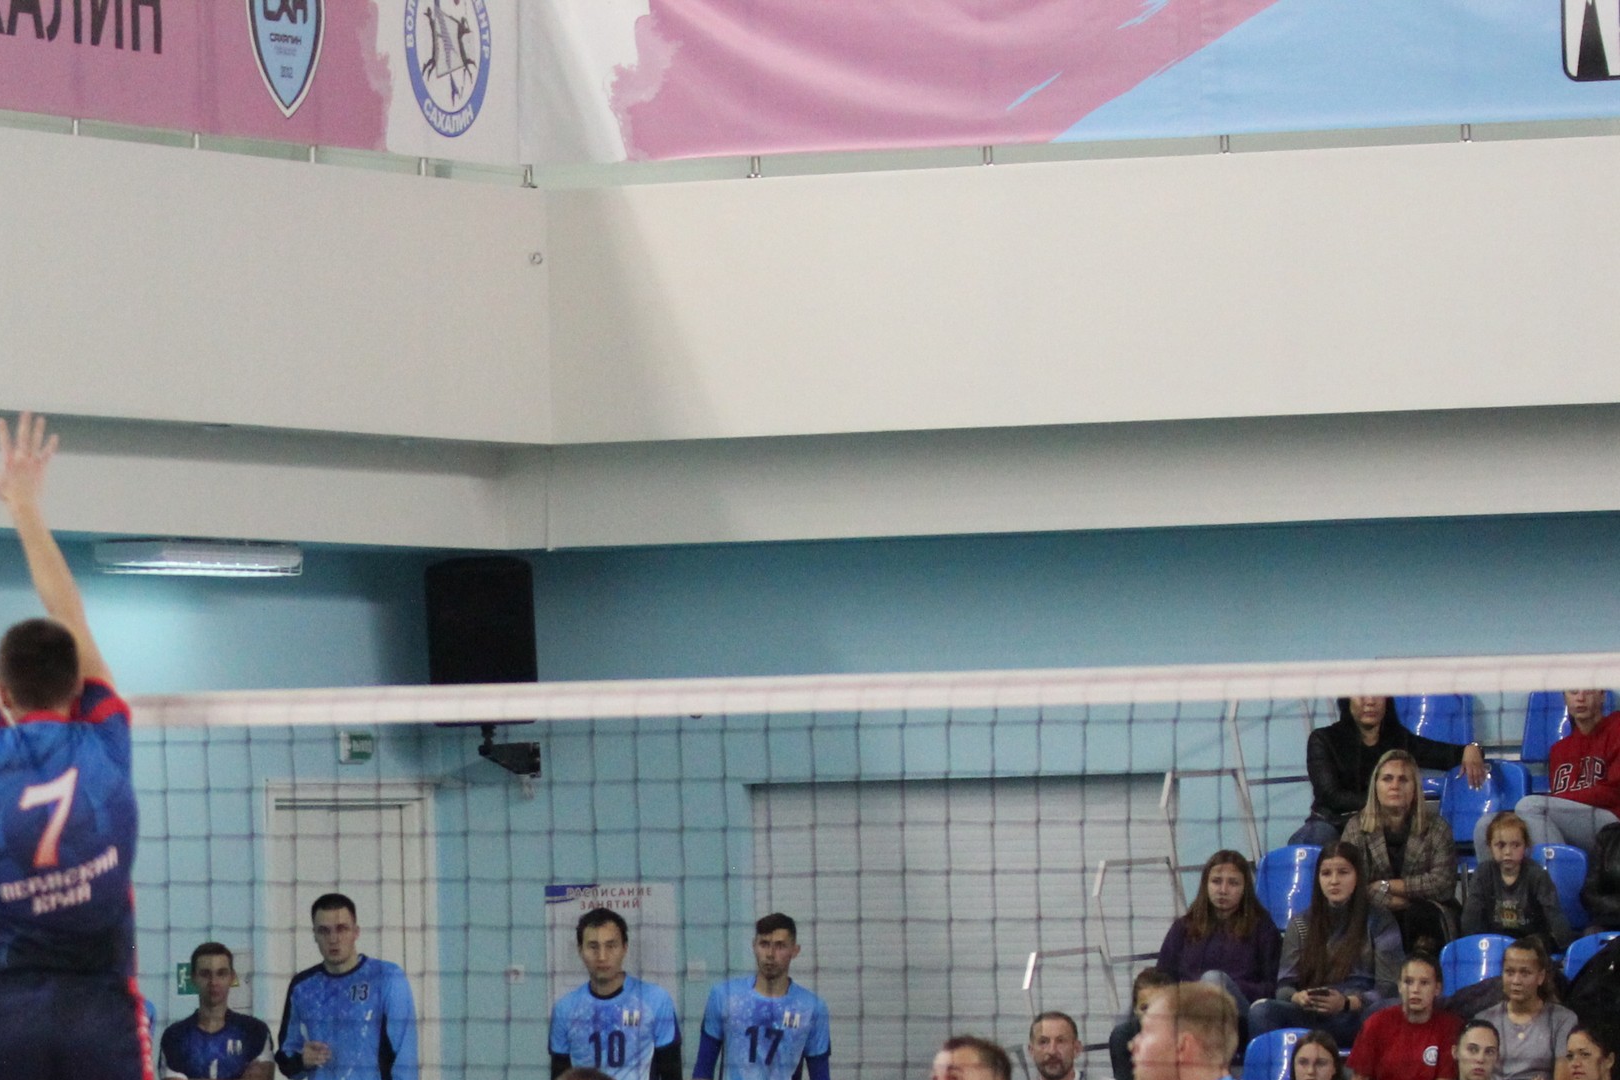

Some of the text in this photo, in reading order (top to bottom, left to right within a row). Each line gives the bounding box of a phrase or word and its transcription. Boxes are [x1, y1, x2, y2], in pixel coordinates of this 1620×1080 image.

[1553, 755, 1607, 795] GAP
[18, 766, 79, 868] 7
[567, 886, 653, 898] РАСПИСАНИЕ
[349, 983, 370, 1002] 13
[588, 1030, 626, 1069] 10
[745, 1025, 785, 1067] 17
